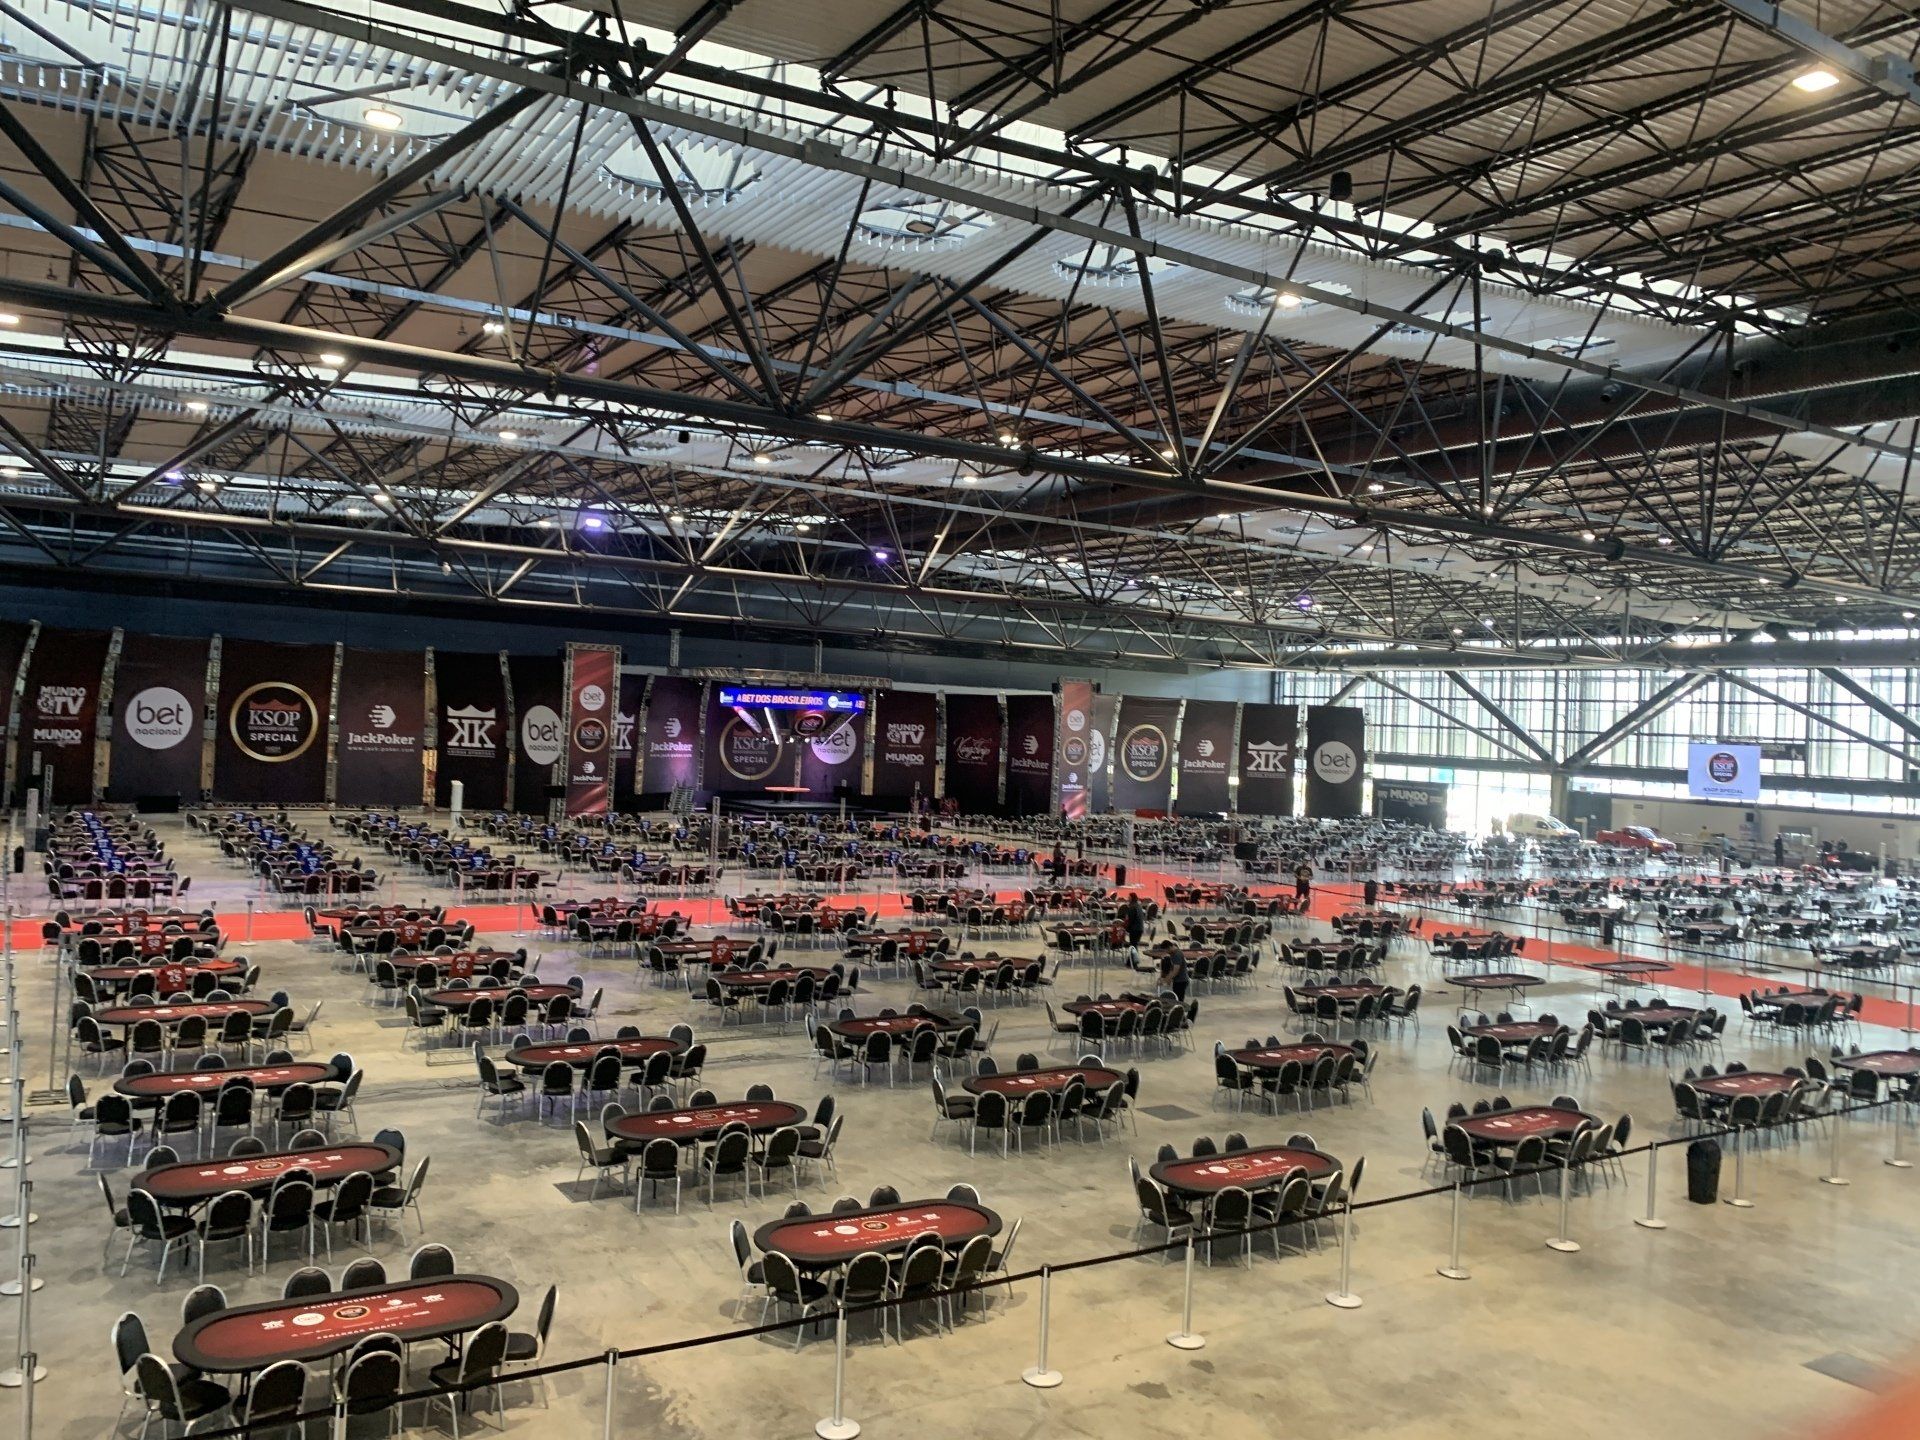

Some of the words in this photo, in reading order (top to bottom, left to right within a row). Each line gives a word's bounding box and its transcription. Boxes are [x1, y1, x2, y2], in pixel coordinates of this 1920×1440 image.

[40, 685, 87, 697] MUNDO
[742, 695, 756, 703] BET
[756, 695, 771, 704] DOS
[772, 695, 824, 706] BRASILEIROS
[136, 700, 183, 725] bet
[248, 709, 301, 726] KSOP
[134, 727, 182, 736] nacional
[527, 718, 559, 742] bet
[888, 723, 925, 731] MUNDO
[33, 728, 82, 740] MUNDO
[250, 732, 298, 742] SPECIAL
[348, 732, 415, 745] JackPoker
[528, 744, 559, 752] nacional
[650, 742, 693, 752] JackPoker
[1131, 744, 1159, 756] KSOP
[734, 755, 768, 764] SPECIAL
[886, 753, 924, 762] MUNDO
[1011, 757, 1050, 769] JackPoker
[1320, 749, 1351, 768] bet
[1131, 760, 1157, 768] SPECIAL
[1183, 759, 1226, 769] JackPoker
[1390, 788, 1428, 802] MUNDO
